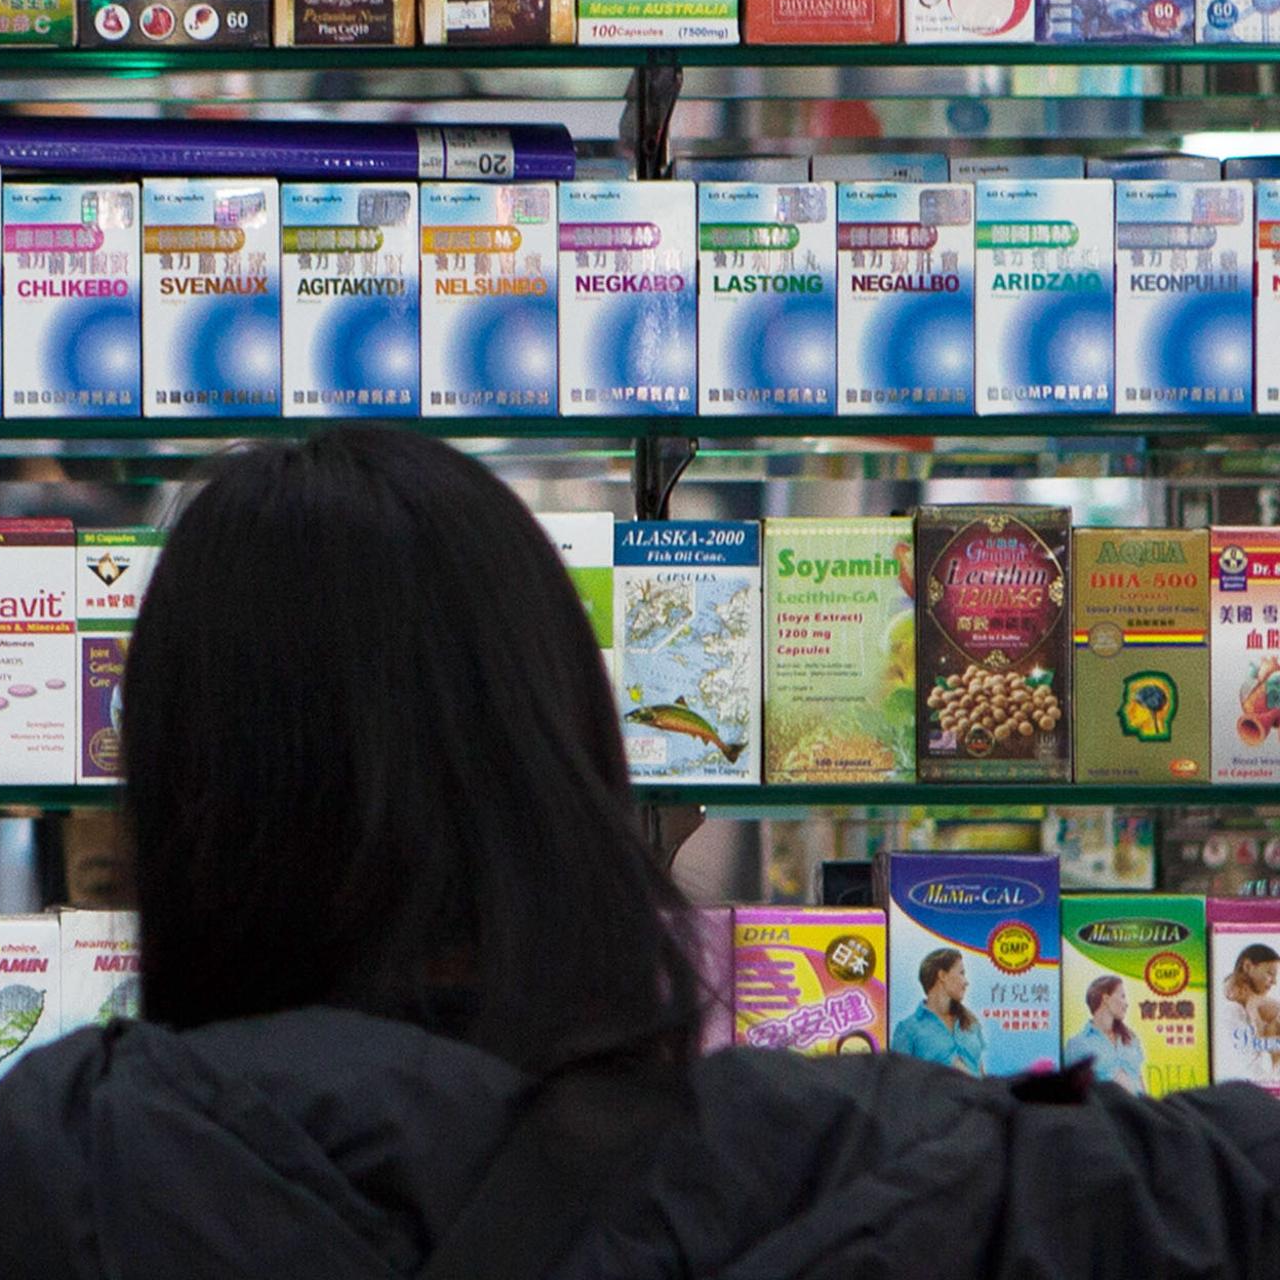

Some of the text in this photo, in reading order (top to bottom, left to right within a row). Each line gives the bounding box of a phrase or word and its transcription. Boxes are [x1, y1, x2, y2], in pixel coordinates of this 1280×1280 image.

[589, 2, 622, 16] Made
[644, 2, 729, 16] AUSTRALIA
[227, 11, 249, 28] 60
[479, 152, 507, 176] 20
[17, 277, 129, 298] CHLIKEBO
[159, 276, 269, 296] SVENAUX
[575, 274, 685, 294] NEGKABO
[713, 274, 824, 295] LASTONG
[851, 274, 960, 294] NEGALLBO
[622, 529, 745, 548] ALASKA-2000
[1096, 541, 1186, 564] AQUA
[778, 548, 901, 581] Soyamin
[1090, 572, 1198, 589] DHA-500
[743, 928, 792, 942] DHA
[1001, 942, 1030, 955] GMP
